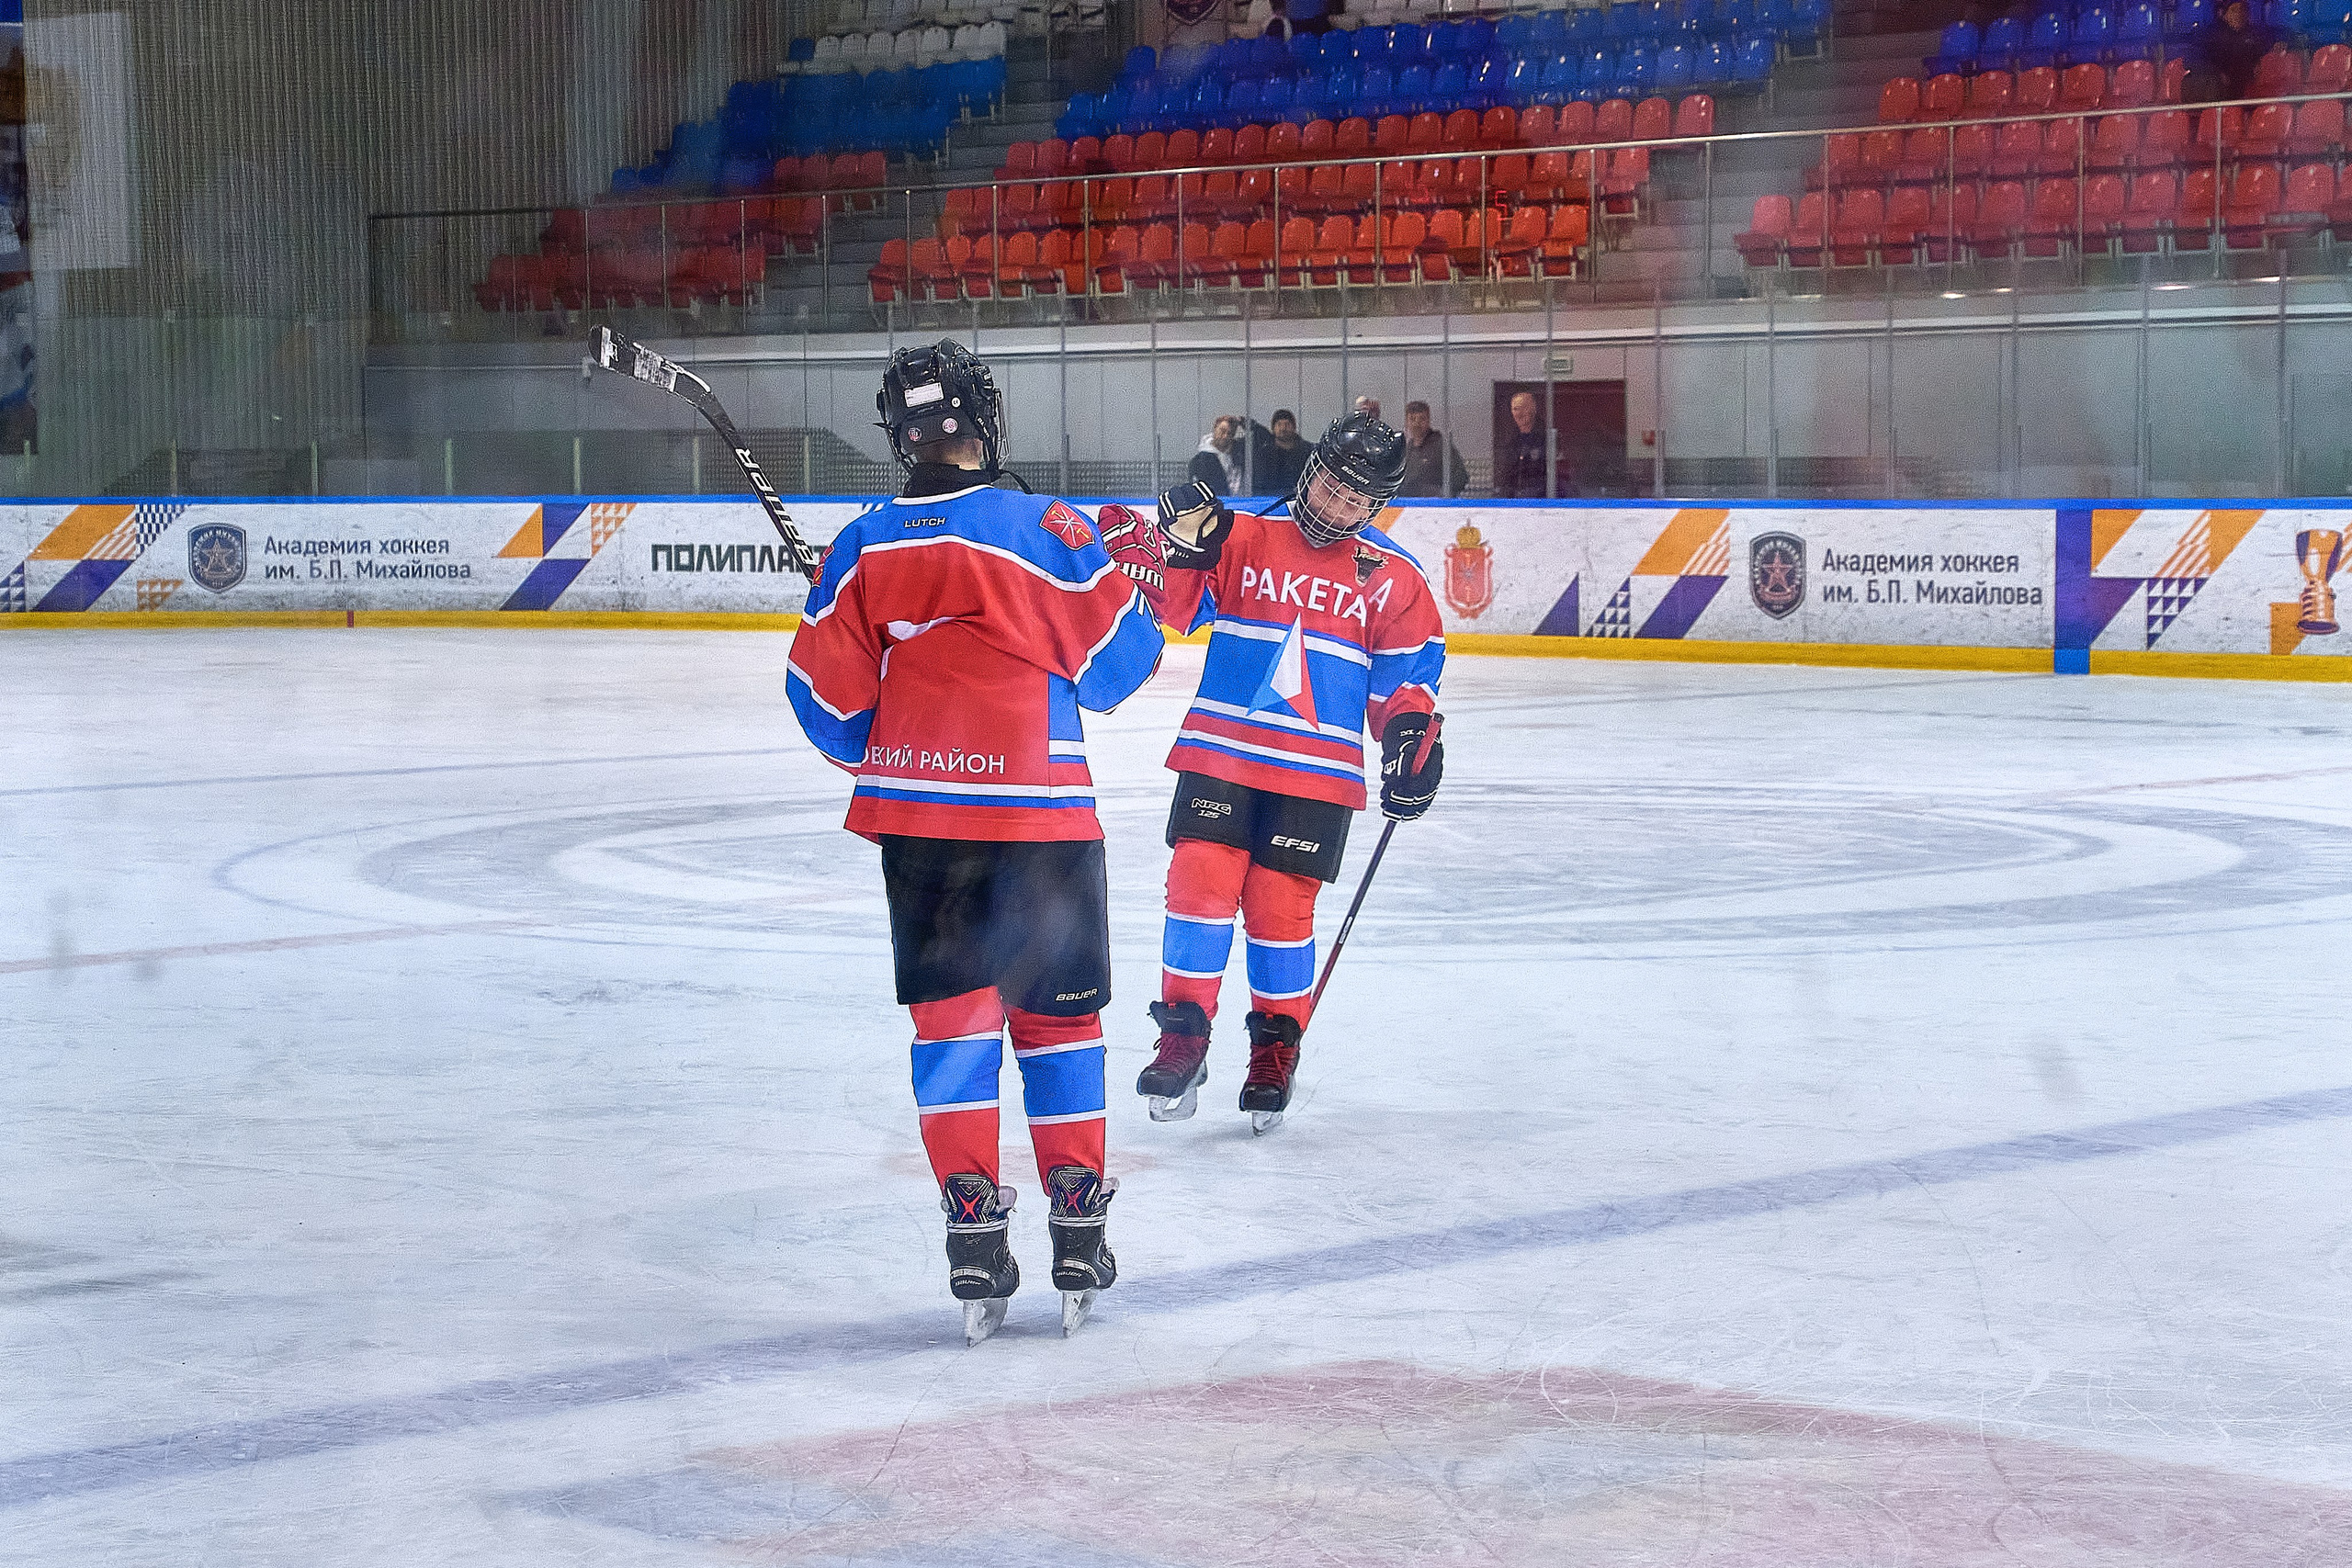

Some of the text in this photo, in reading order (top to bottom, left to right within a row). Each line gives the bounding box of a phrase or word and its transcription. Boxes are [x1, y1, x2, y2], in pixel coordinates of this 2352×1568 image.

[904, 517, 946, 528] LUTCH
[264, 536, 450, 558] Академия хоккея
[265, 559, 471, 580] им. Б.П. Михайлова
[1822, 548, 2019, 575] Академия хоккея
[1241, 566, 1368, 627] РАКЕТА
[1823, 580, 2042, 605] им. Б.П. Михайлова
[920, 748, 1004, 774] РАЙОН
[1271, 835, 1320, 853] EFSI
[1056, 987, 1098, 1001] BAUER
